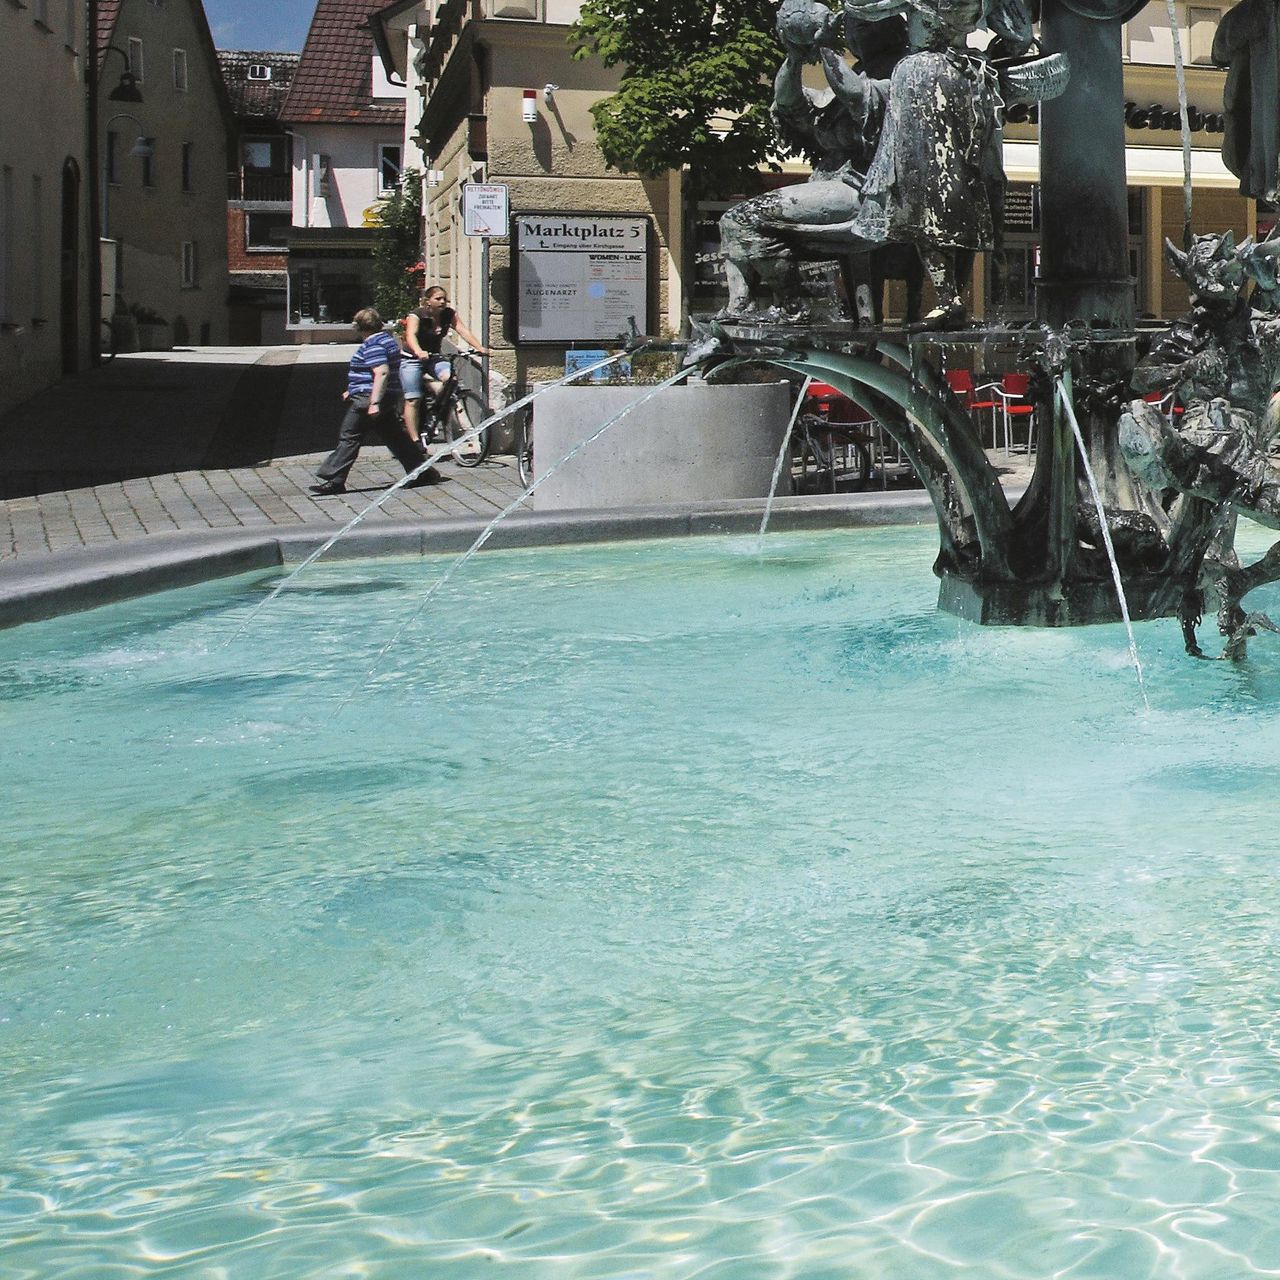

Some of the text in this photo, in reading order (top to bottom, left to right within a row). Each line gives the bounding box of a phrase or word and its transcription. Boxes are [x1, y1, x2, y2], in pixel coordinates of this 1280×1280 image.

[525, 223, 640, 240] Marktplatz 5
[525, 288, 577, 296] AUGENARZT
